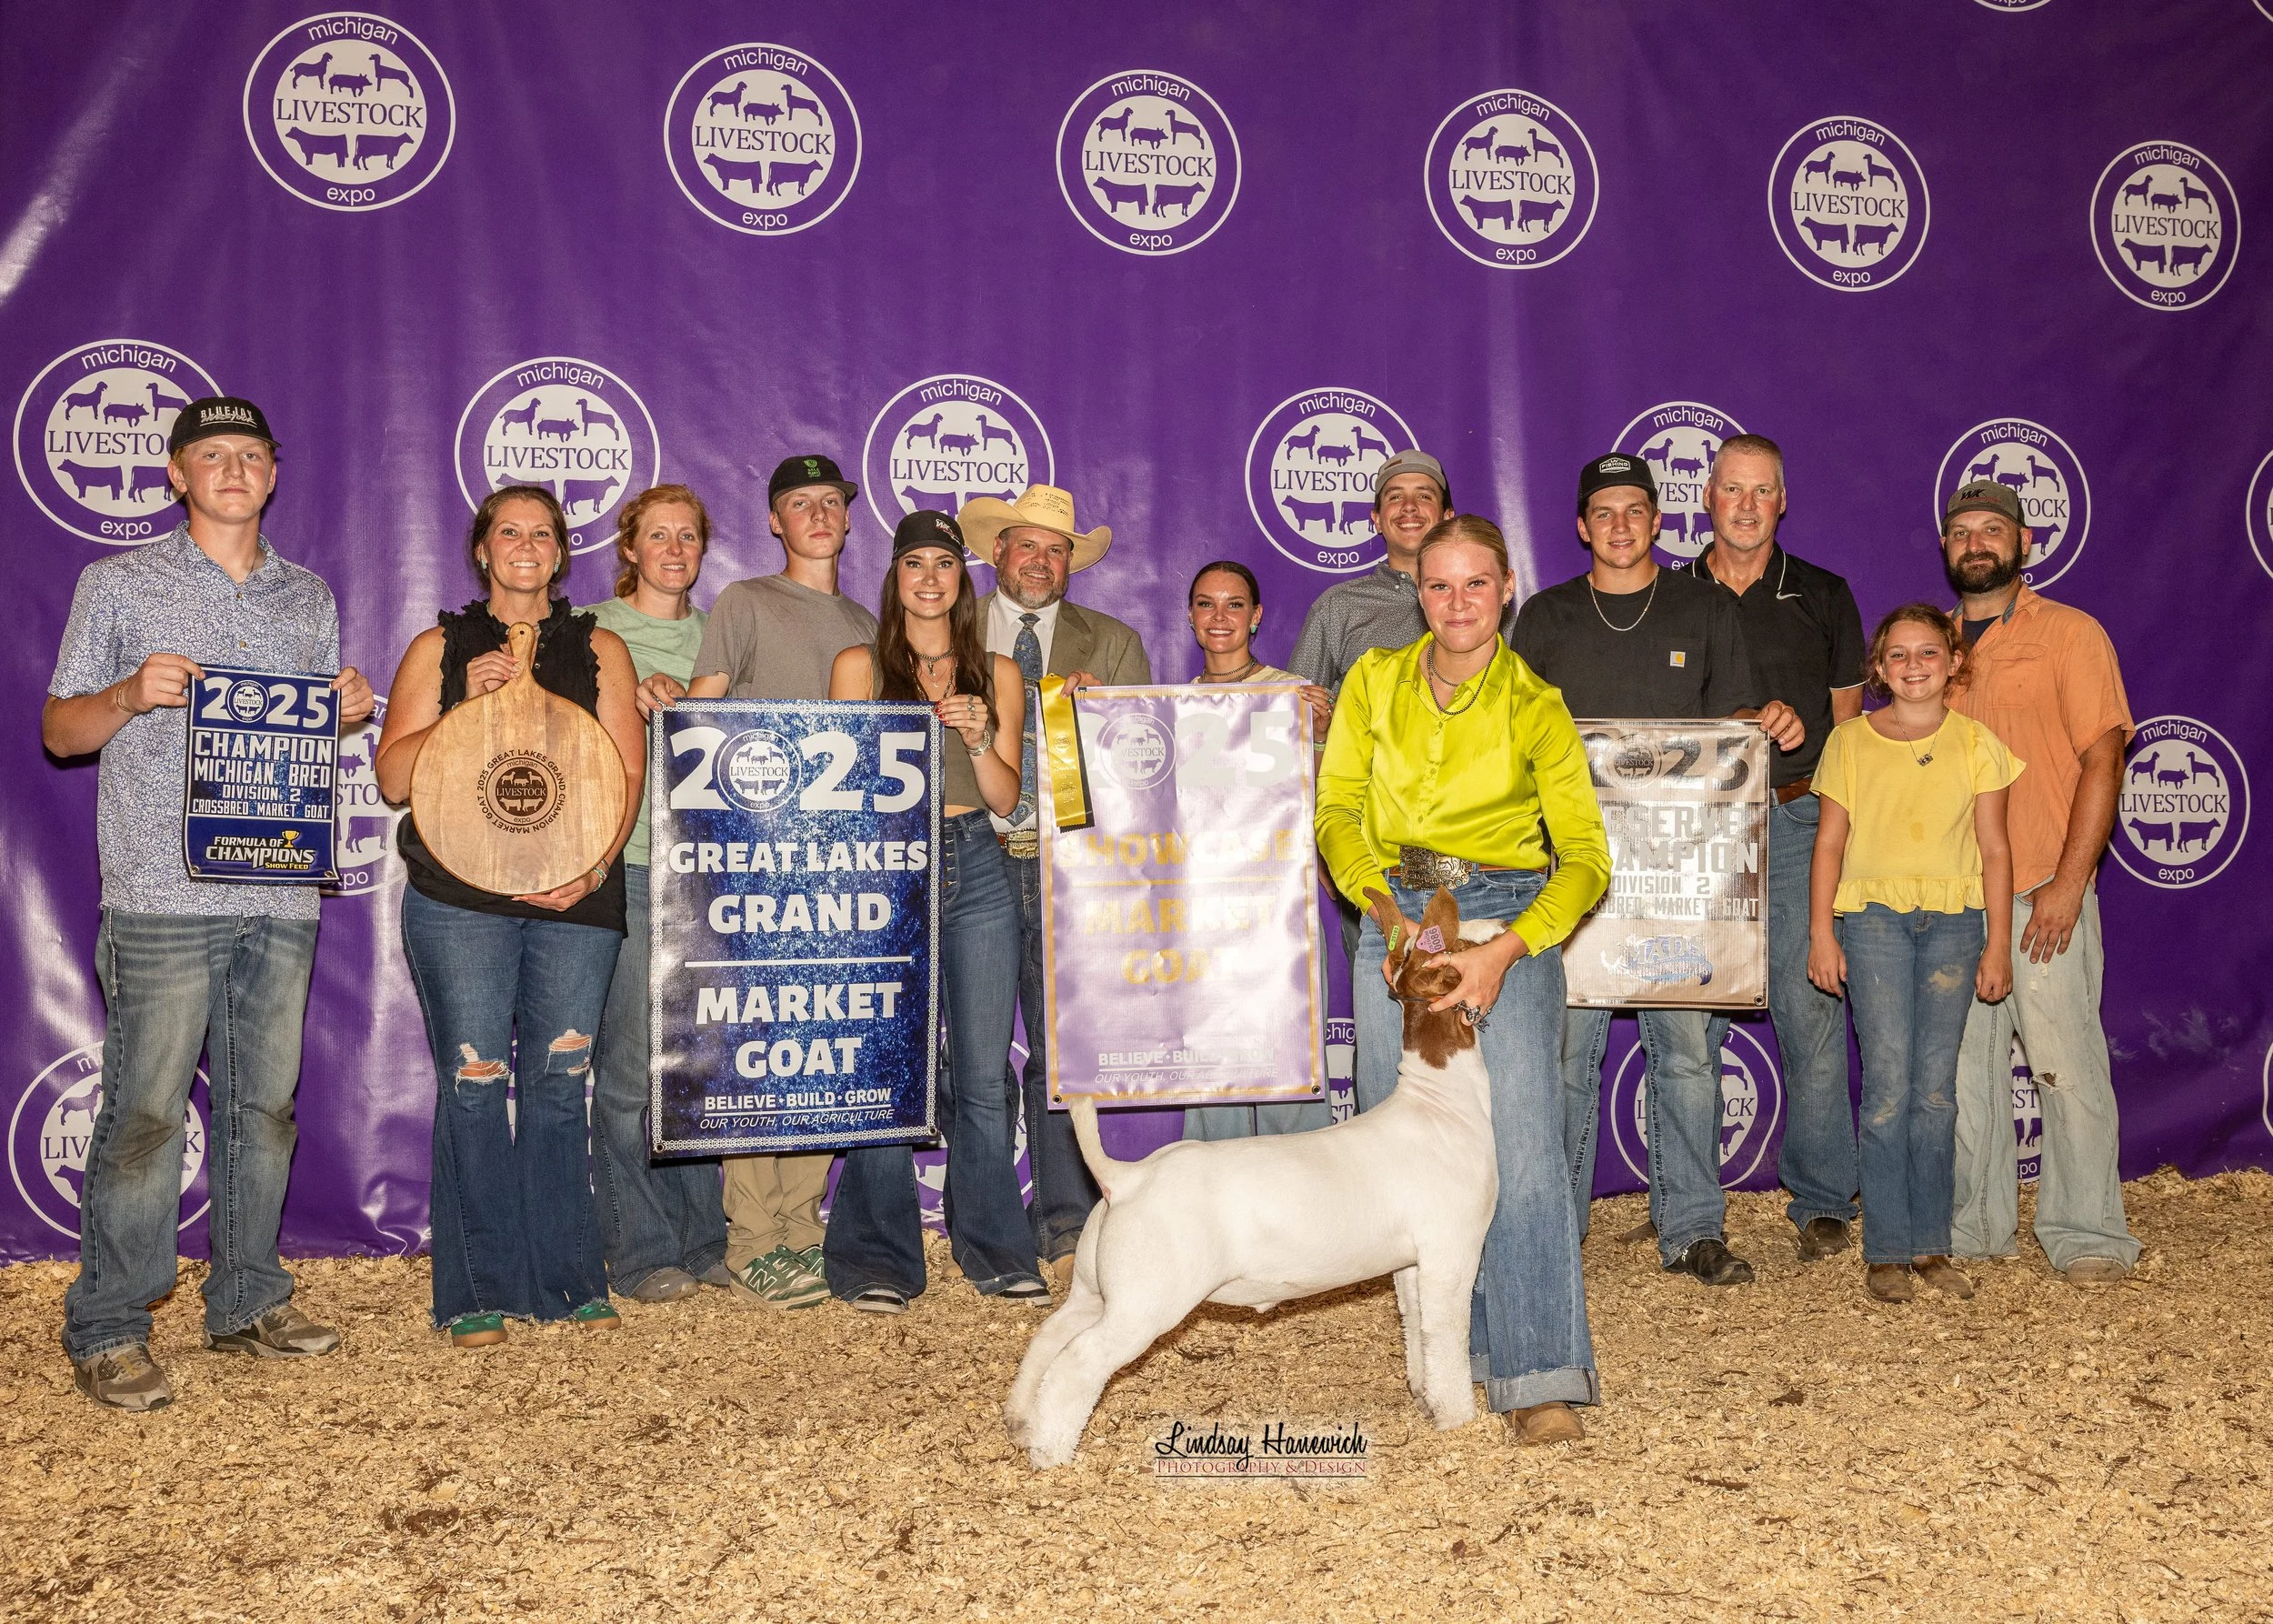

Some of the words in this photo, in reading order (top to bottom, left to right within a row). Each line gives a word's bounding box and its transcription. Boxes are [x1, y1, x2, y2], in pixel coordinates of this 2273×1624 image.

[308, 17, 398, 45] michigan
[724, 48, 807, 75] michigan
[1111, 75, 1190, 101] michigan
[276, 98, 424, 128] LIVESTOCK
[1477, 94, 1550, 121] michigan
[695, 125, 832, 155] LIVESTOCK
[1816, 120, 1885, 145] michigan
[1085, 150, 1214, 177] LIVESTOCK
[2134, 145, 2200, 169] michigan
[1451, 169, 1572, 195] LIVESTOCK
[326, 187, 375, 206] expo
[1793, 191, 1906, 218] LIVESTOCK
[742, 212, 787, 230] expo
[2114, 214, 2218, 240] LIVESTOCK
[1129, 233, 1173, 250] expo
[1496, 247, 1537, 264] expo
[1833, 270, 1871, 286] expo
[2150, 289, 2186, 306] expo
[81, 345, 177, 373] michigan
[516, 362, 605, 389] michigan
[920, 379, 1003, 406] michigan
[1298, 392, 1376, 417] michigan
[1653, 406, 1724, 431] michigan
[1980, 423, 2048, 446] michigan
[486, 445, 629, 471] LIVESTOCK
[892, 458, 1026, 484] LIVESTOCK
[100, 520, 153, 540] expo
[1317, 551, 1359, 568] expo
[2142, 721, 2207, 743] michigan
[195, 731, 332, 764] CHAMPION
[487, 749, 515, 769] GREAT
[517, 749, 547, 763] LAKES
[194, 757, 275, 786] MICHIGAN
[288, 764, 331, 788] BRED
[506, 759, 538, 768] michigan
[730, 767, 788, 777] LIVESTOCK
[477, 769, 489, 791] 2025
[547, 761, 566, 791] GRAND
[222, 785, 278, 800] DIVISION
[289, 788, 302, 802] 2
[496, 787, 546, 797] LIVESTOCK
[2120, 793, 2227, 813] LIVESTOCK
[193, 798, 249, 816] CROSSBRED
[257, 802, 297, 817] MARKET
[305, 805, 329, 818] GOAT
[477, 796, 493, 819] GOAT
[533, 793, 566, 832] CHAMPION
[492, 818, 530, 834] MARKET
[1603, 806, 1745, 839] ESERVE
[214, 836, 267, 847] FORMULA
[269, 838, 284, 847] OF
[1057, 828, 1298, 867] SHOWCASE
[205, 846, 316, 868] CHAMPIONS
[668, 842, 798, 873] GREAT
[806, 840, 928, 872] LAKES
[1614, 842, 1758, 874] AMPION
[1613, 876, 1682, 895] DIVISION
[1697, 877, 1710, 895] 2
[2158, 867, 2195, 884] expo
[708, 893, 892, 934] GRAND
[1654, 897, 1712, 915] MARKET
[1723, 898, 1758, 917] GOAT
[696, 981, 902, 1025] MARKET
[735, 1038, 862, 1078] GOAT
[1098, 1050, 1164, 1066] BELIEVE
[1095, 1074, 1121, 1083] OUR
[705, 1094, 776, 1110] BELIEVE
[786, 1091, 836, 1108] BUILD
[845, 1088, 891, 1104] GROW
[699, 1118, 728, 1129] OUR
[731, 1117, 778, 1128] YOUTH,
[782, 1115, 812, 1127] OUR
[812, 1109, 895, 1125] AGRICULTURE
